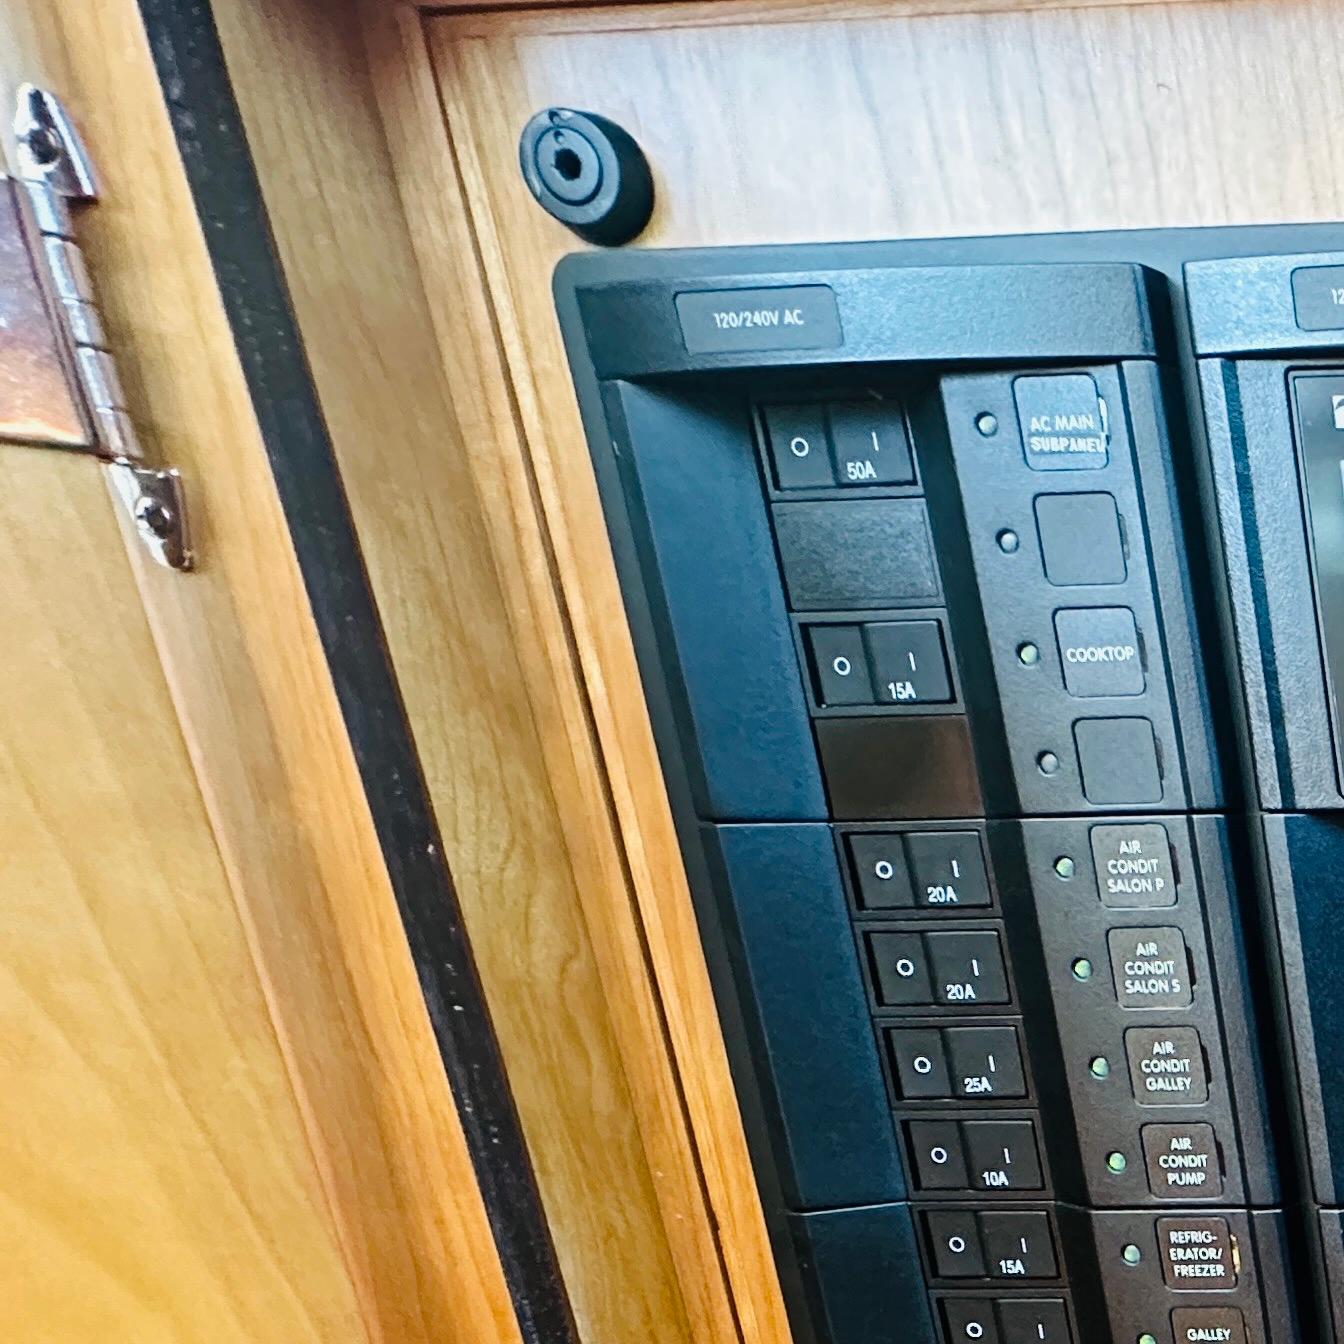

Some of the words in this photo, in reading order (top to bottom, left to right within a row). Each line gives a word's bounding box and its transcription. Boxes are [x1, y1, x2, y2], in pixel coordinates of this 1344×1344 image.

[714, 310, 779, 329] 120/240V
[783, 310, 804, 326] AC
[1030, 416, 1050, 432] AC
[1055, 415, 1093, 430] MAIN
[847, 462, 876, 480] 50A
[1066, 646, 1134, 663] COOKTOP
[1119, 840, 1141, 854] AIR
[1107, 859, 1158, 875] CONDIT
[1107, 878, 1152, 893] SALON
[1156, 879, 1165, 893] P
[927, 887, 958, 903] 20A
[1136, 942, 1158, 957] AIR
[1124, 960, 1175, 975] CONDIT
[1125, 978, 1168, 994] SALON
[1171, 979, 1180, 993] S
[1170, 1137, 1192, 1150] AIR
[1159, 1153, 1208, 1168] CONDIT
[1167, 1171, 1206, 1186] PUMP
[1169, 1231, 1217, 1245] REFRIG-
[1169, 1247, 1222, 1261] ERATOR/
[1174, 1264, 1225, 1278] FREEZER
[1187, 1328, 1230, 1342] GALLEY
